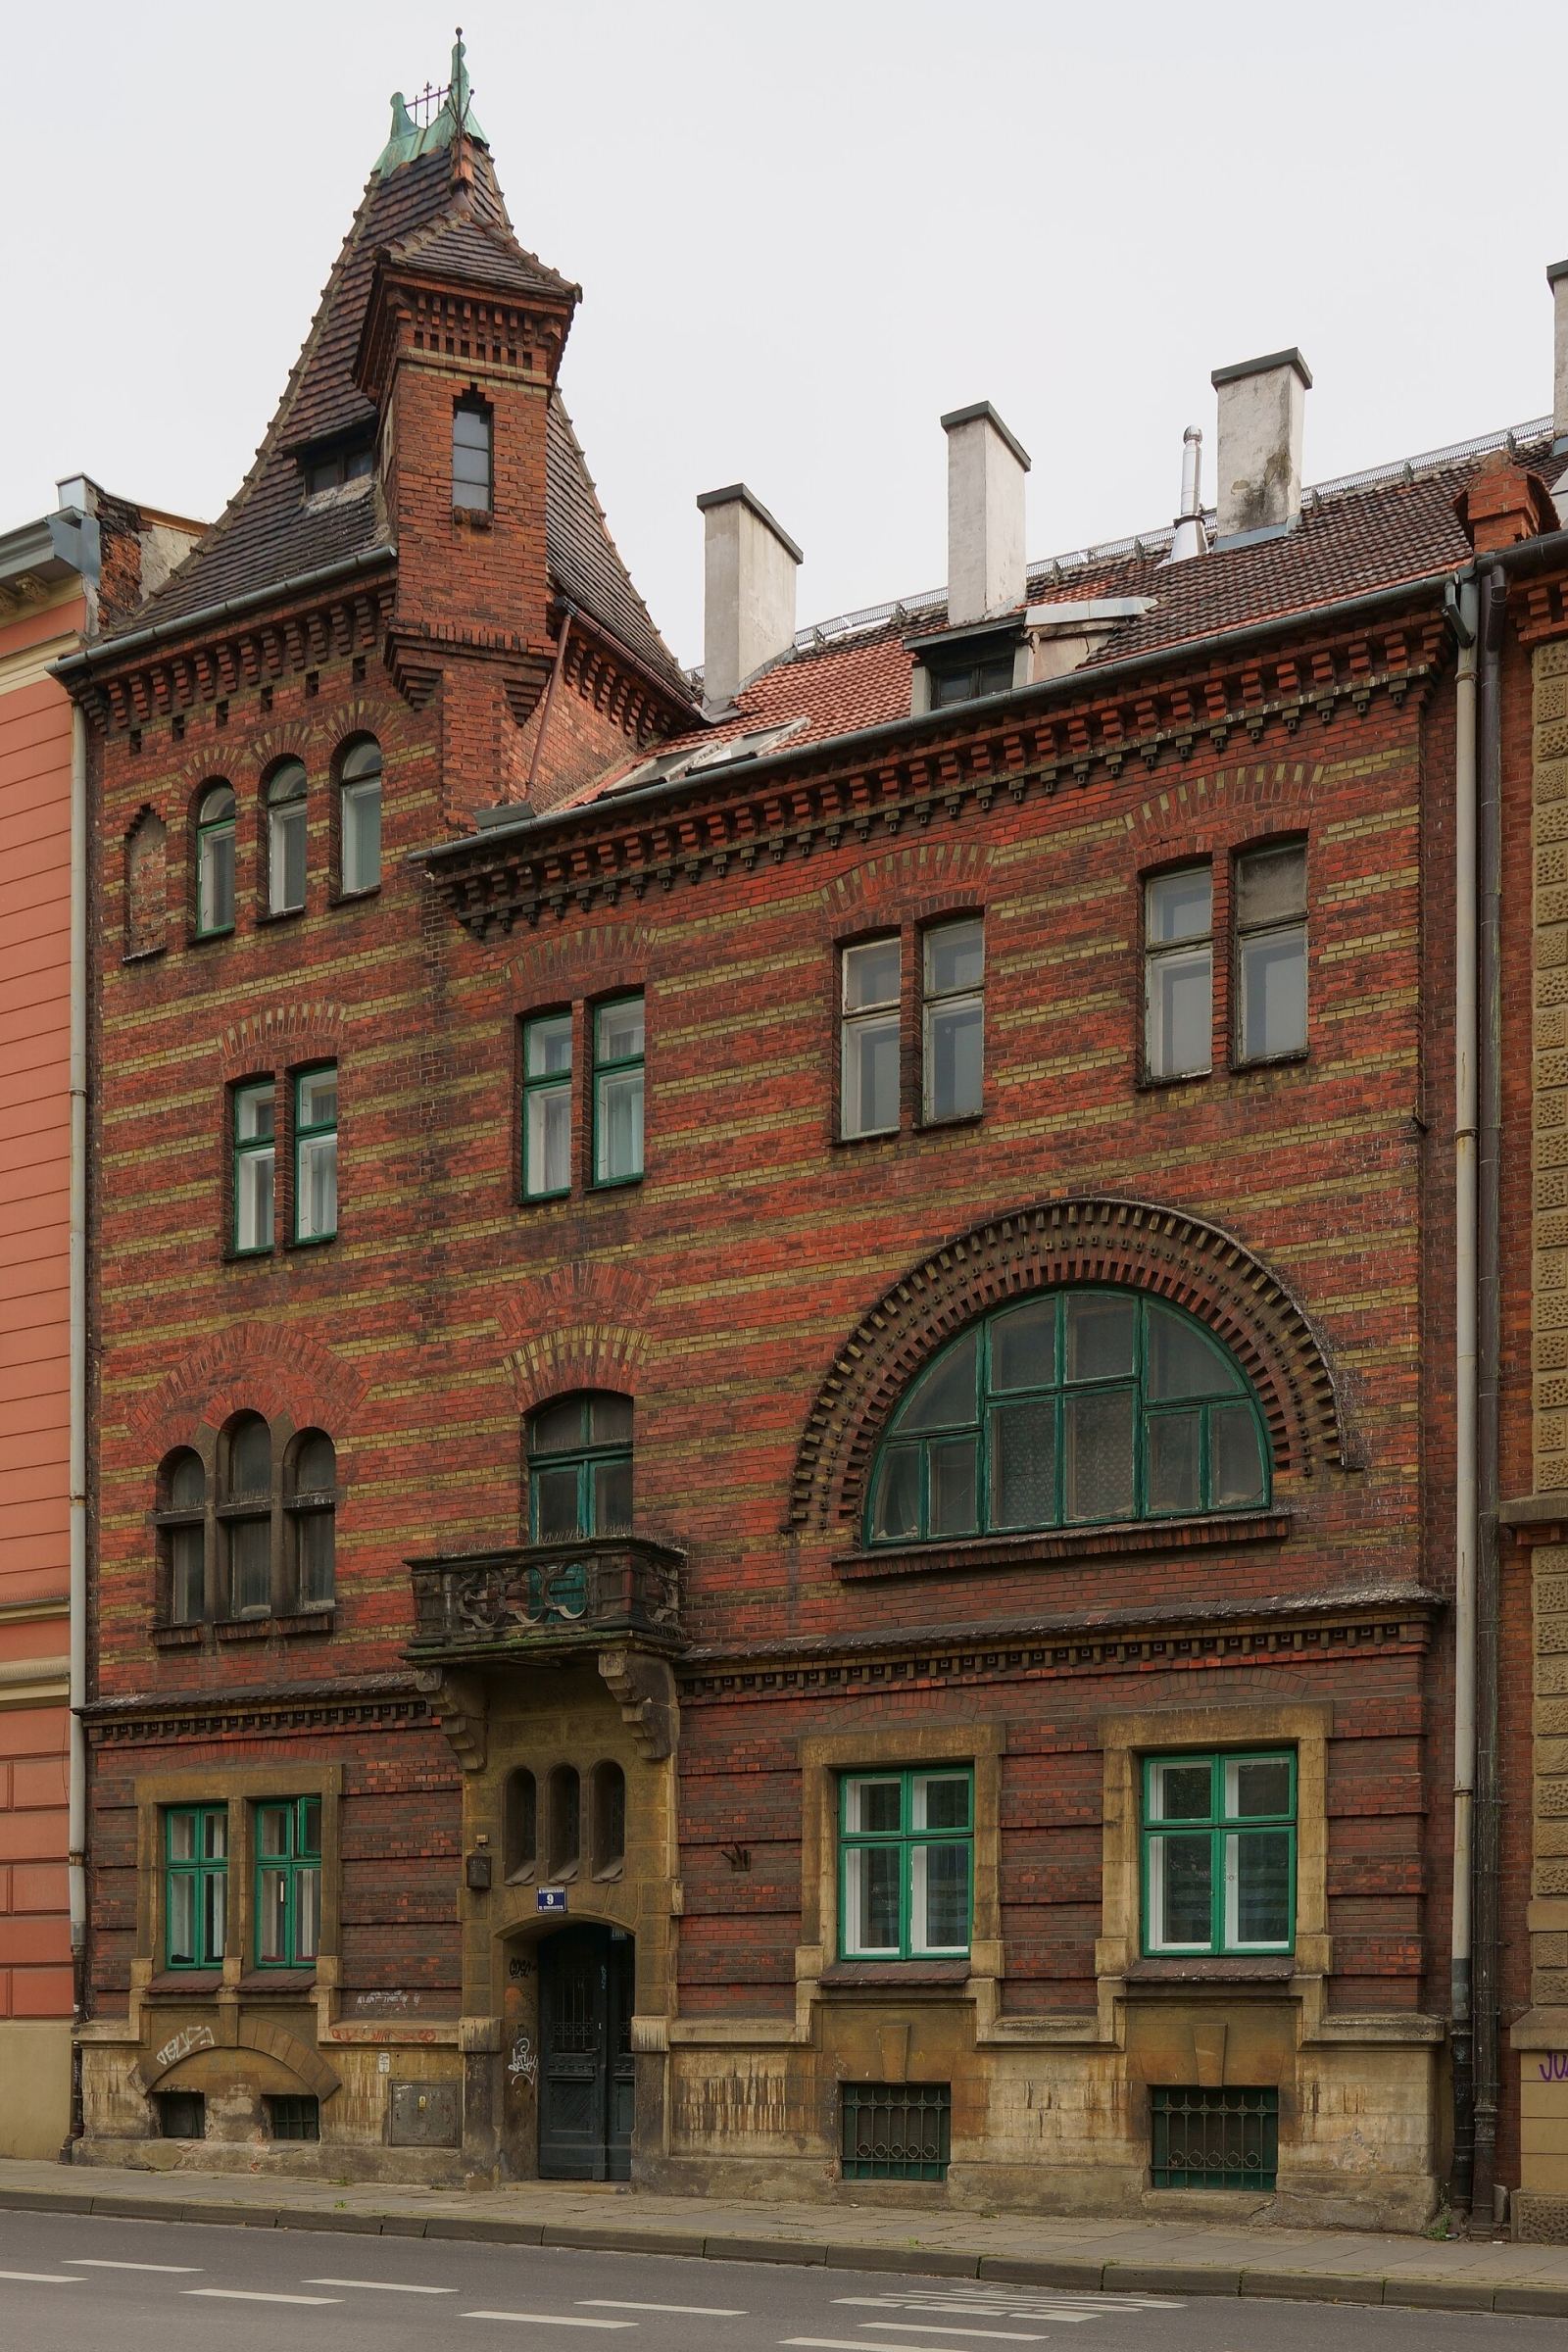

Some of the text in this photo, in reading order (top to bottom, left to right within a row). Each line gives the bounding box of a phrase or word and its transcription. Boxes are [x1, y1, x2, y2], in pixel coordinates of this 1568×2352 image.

[547, 1893, 554, 1905] 9
[1539, 2051, 1568, 2082] JU
[829, 2288, 1188, 2322] BUS
